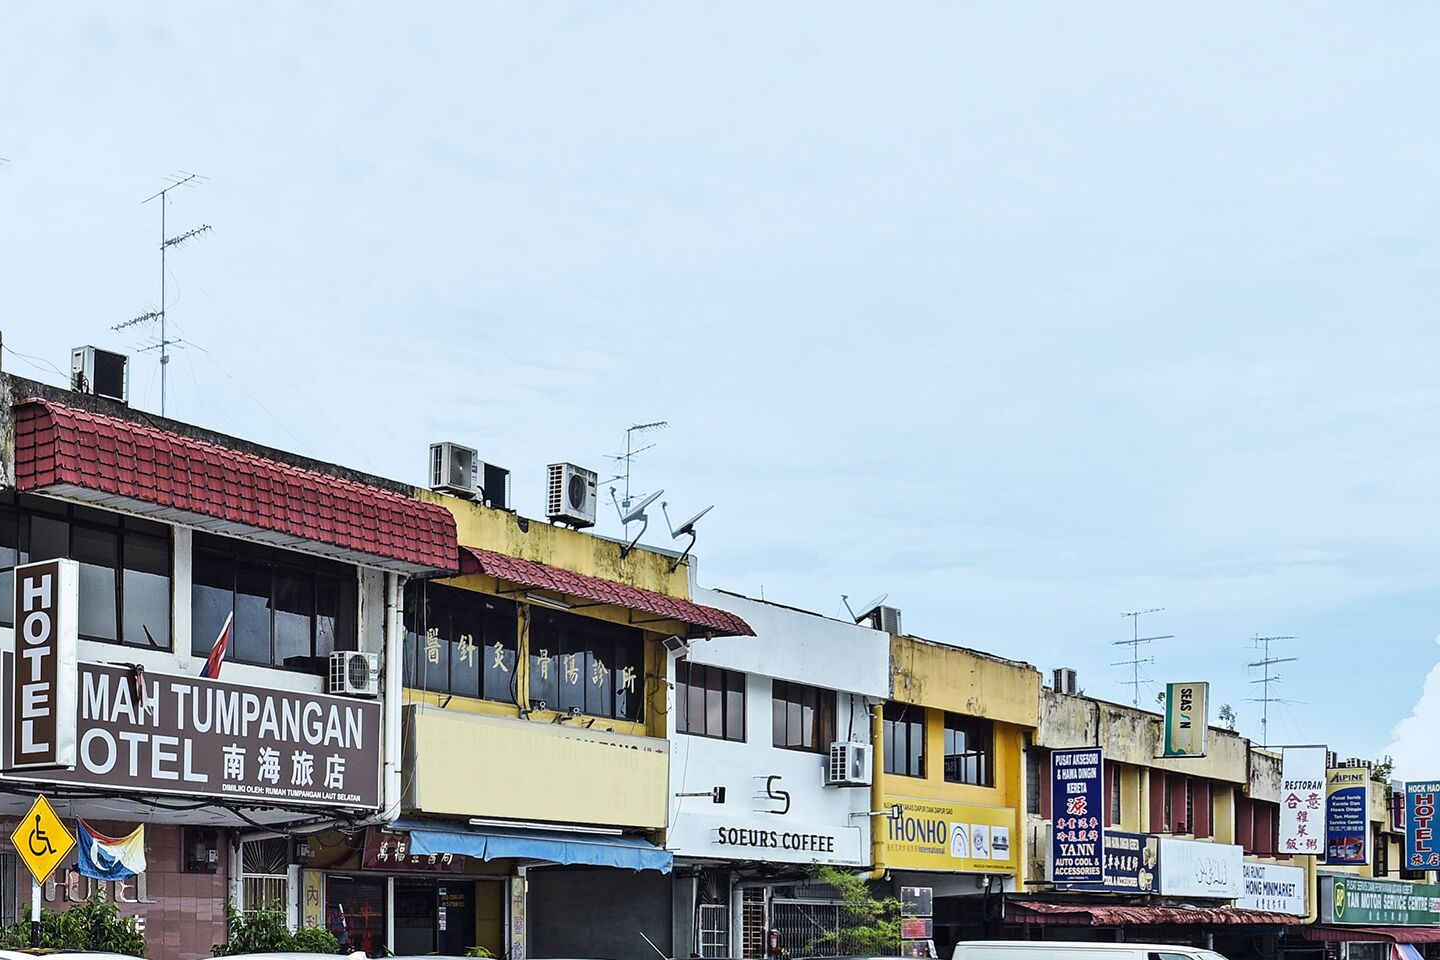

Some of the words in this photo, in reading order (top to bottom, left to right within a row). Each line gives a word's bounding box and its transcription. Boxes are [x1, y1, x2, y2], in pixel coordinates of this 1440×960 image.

[21, 573, 52, 754] HOTEL
[171, 683, 363, 750] TUMPANGAN
[80, 728, 208, 783] OTEL
[1055, 754, 1072, 766] PUSAT
[222, 743, 346, 790] 南海旅店
[1284, 780, 1322, 790] RESTORAN
[1330, 771, 1363, 783] ALPINE
[265, 788, 286, 796] RUMAH
[287, 789, 321, 799] TUMPANGAN
[322, 791, 336, 800] LAUT
[337, 793, 361, 802] SELATAN
[1408, 784, 1426, 793] HOCK
[1066, 796, 1087, 817] 源
[1284, 792, 1321, 809] 合意
[886, 815, 947, 845] THONHO
[1414, 793, 1435, 852] HOTEL
[719, 827, 777, 848] SOEURS
[782, 832, 834, 852] COFFEE
[1059, 844, 1095, 856] YANN
[1055, 857, 1074, 866] AUTO
[1074, 857, 1093, 866] COOL
[1094, 858, 1100, 866] &
[1055, 867, 1101, 875] ACCESSORIES
[1246, 880, 1262, 895] HONG
[1263, 881, 1295, 898] MINIMARKET
[1347, 892, 1360, 908] TAN
[1361, 893, 1382, 909] MOTOR
[1383, 894, 1407, 910] SERVICE
[1408, 896, 1428, 911] CENTRE
